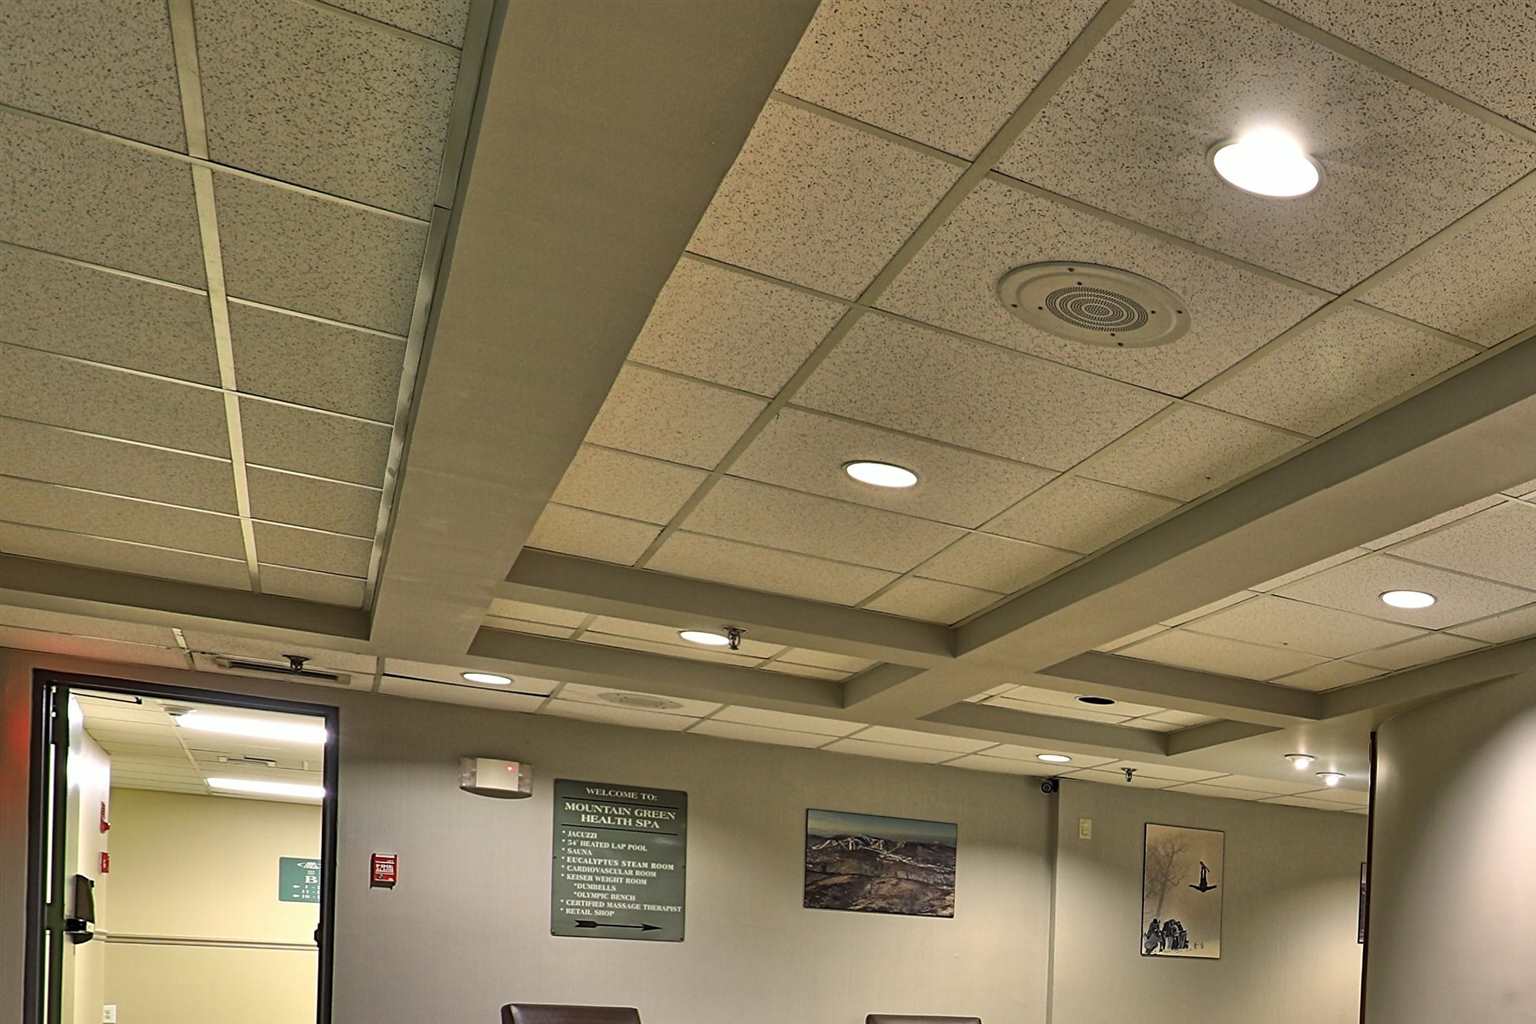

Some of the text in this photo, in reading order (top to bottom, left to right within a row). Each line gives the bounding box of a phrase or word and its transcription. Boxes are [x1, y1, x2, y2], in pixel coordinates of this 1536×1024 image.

[585, 787, 638, 799] WELCOME
[564, 802, 676, 819] MOUNTAIN GREEN
[581, 814, 660, 828] HEALTH SPA
[567, 830, 598, 839] JACUZZI
[567, 847, 593, 856] SAUNA
[580, 840, 610, 848] HEATED
[628, 844, 648, 852] POOL
[566, 856, 675, 871] EUCALYPTUS STEAM ROOM
[566, 865, 657, 878] CARDIOVASCULAR ROOM
[595, 875, 624, 884] WEIGHT
[625, 877, 647, 885] ROOM
[610, 893, 636, 901] BENCH
[565, 899, 683, 912] CERTIFIED MASSAGE THERAPIST
[565, 908, 616, 917] RETAIL SHOP
